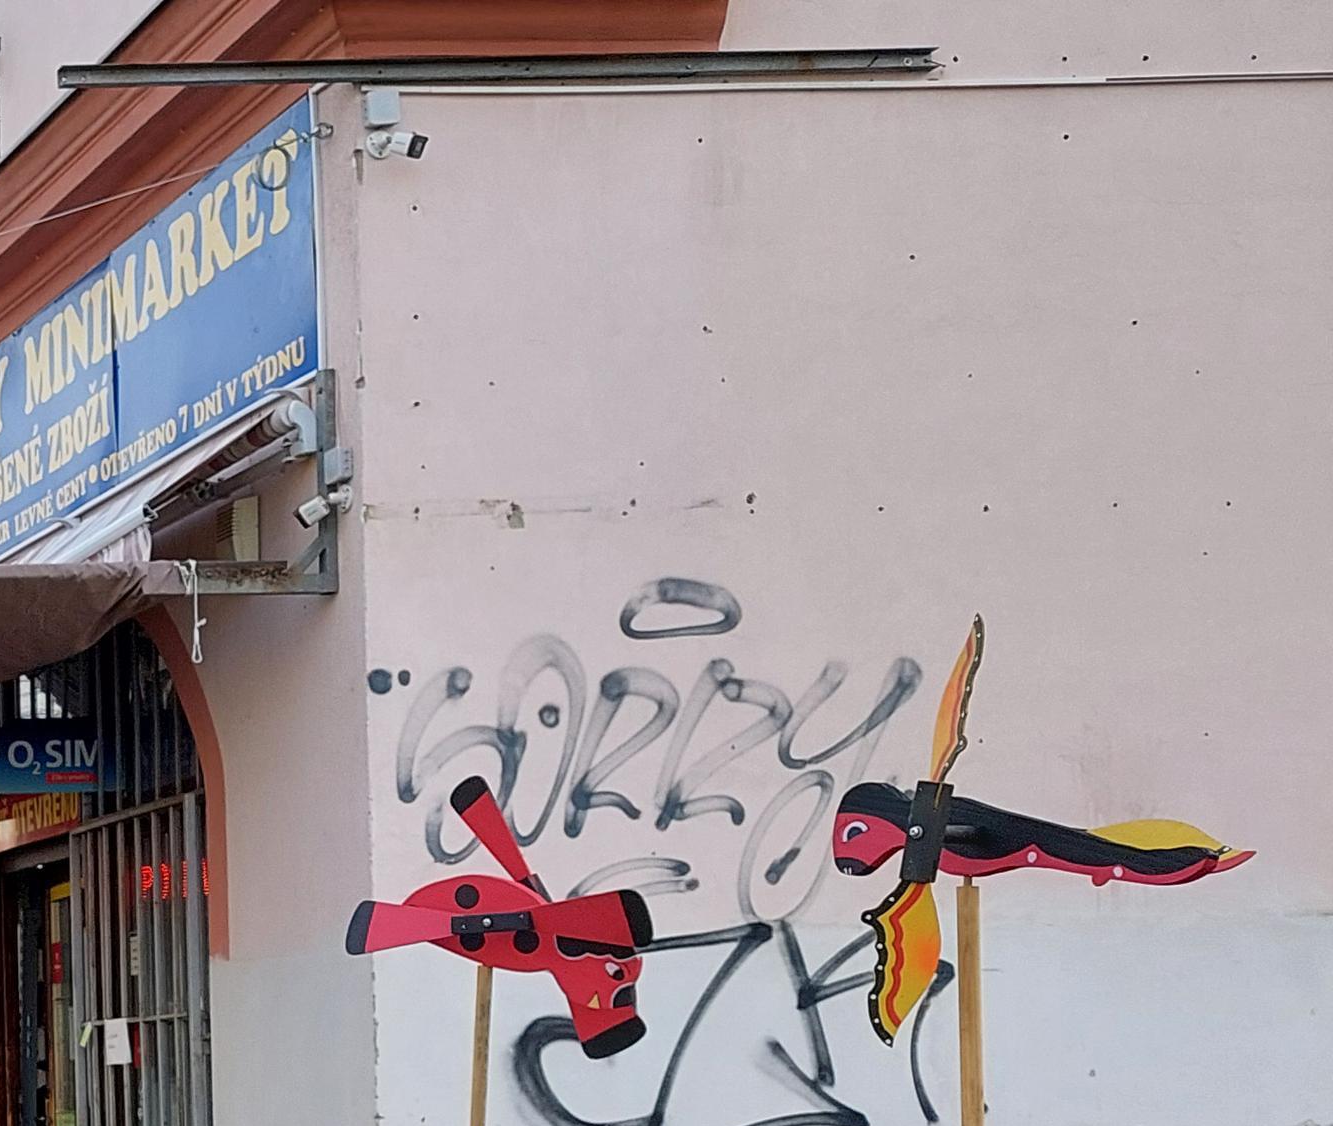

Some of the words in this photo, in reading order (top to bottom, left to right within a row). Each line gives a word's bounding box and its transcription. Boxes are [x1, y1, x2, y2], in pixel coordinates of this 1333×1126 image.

[24, 128, 298, 416] MINIMARKET
[13, 490, 54, 537] LEVNÉ
[55, 471, 88, 511] CENY
[99, 418, 177, 483] OTEVŘENO
[178, 405, 190, 434] 7
[193, 388, 223, 428] DNÍ
[226, 378, 238, 406] V
[240, 336, 306, 399] TÝDNU
[46, 373, 111, 474] ZBOŽÍ
[44, 739, 100, 769] SIM
